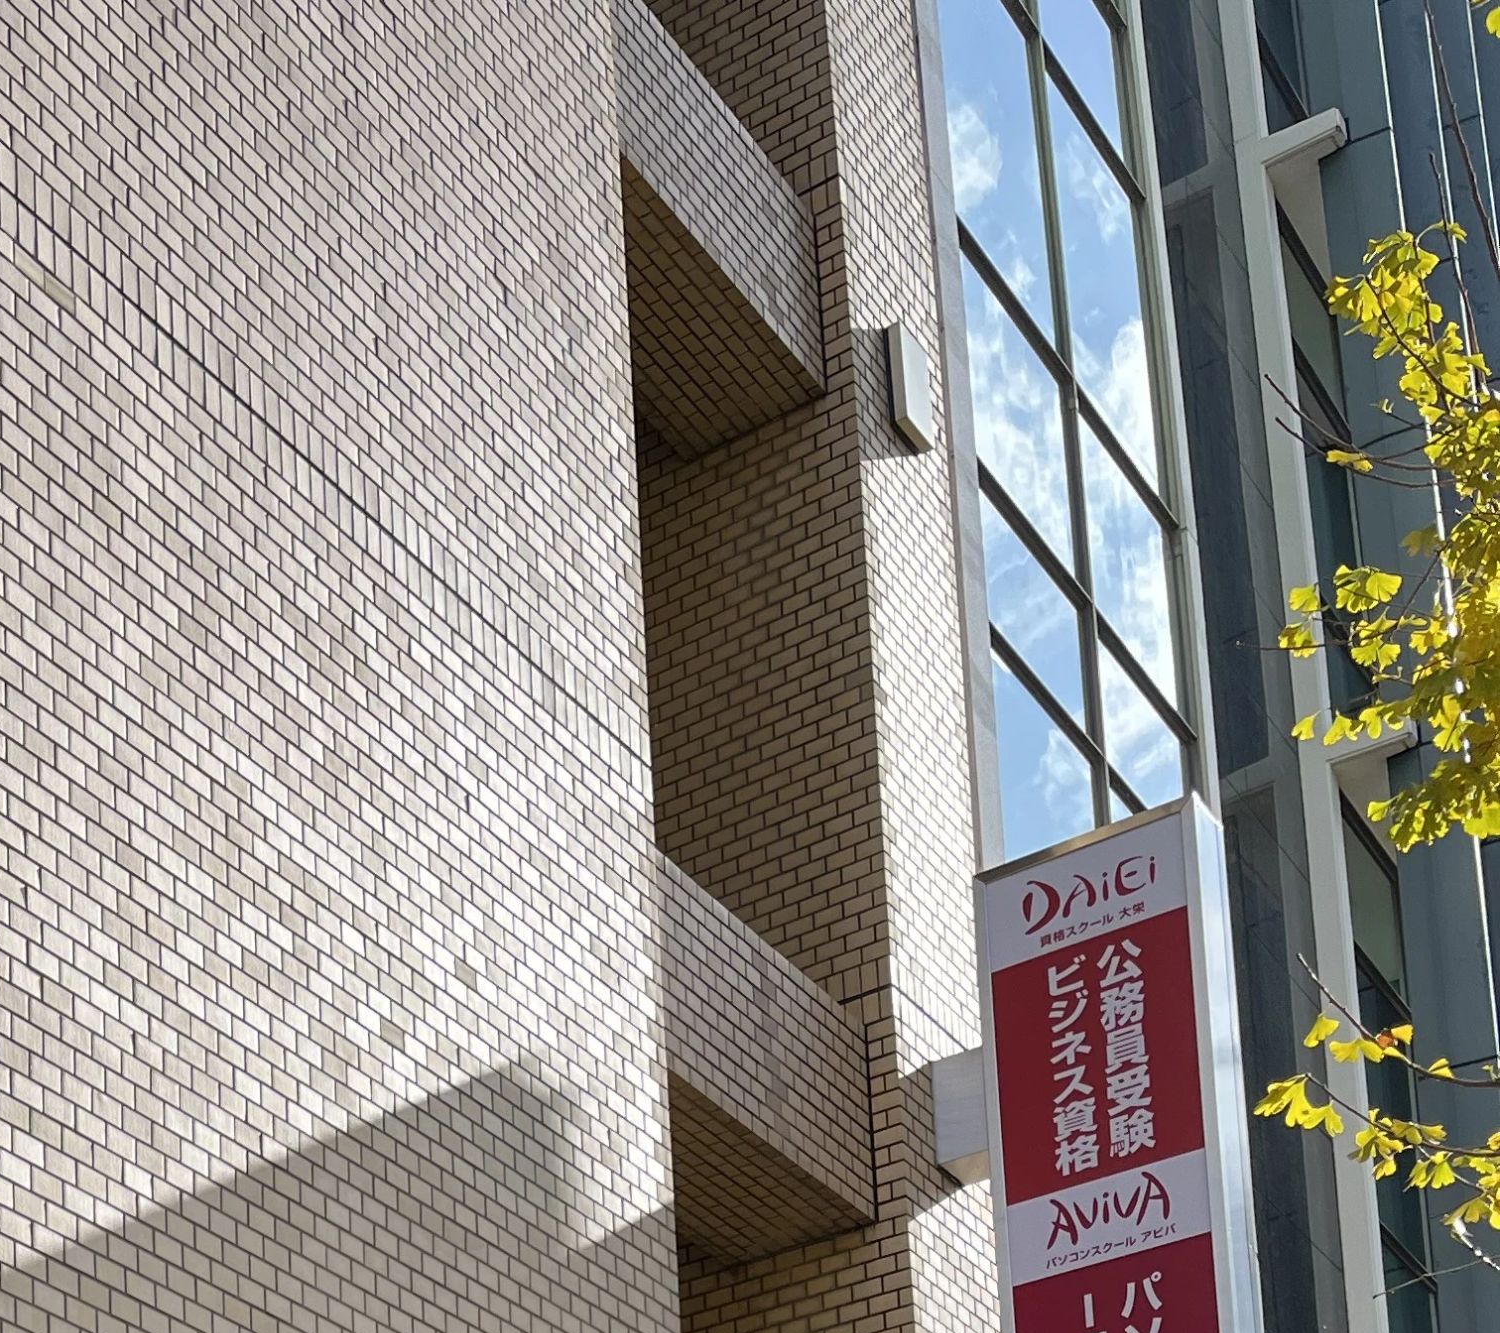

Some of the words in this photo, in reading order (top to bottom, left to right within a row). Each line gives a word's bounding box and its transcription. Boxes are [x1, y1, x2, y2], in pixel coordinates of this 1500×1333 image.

[1040, 913, 1114, 947] 資格スクール
[1119, 902, 1146, 920] 大栄
[1047, 953, 1100, 1177] ビジネス資格
[1097, 939, 1157, 1158] 公務員受験
[1046, 1236, 1137, 1269] パソコンスクール
[1141, 1223, 1177, 1243] アビバ
